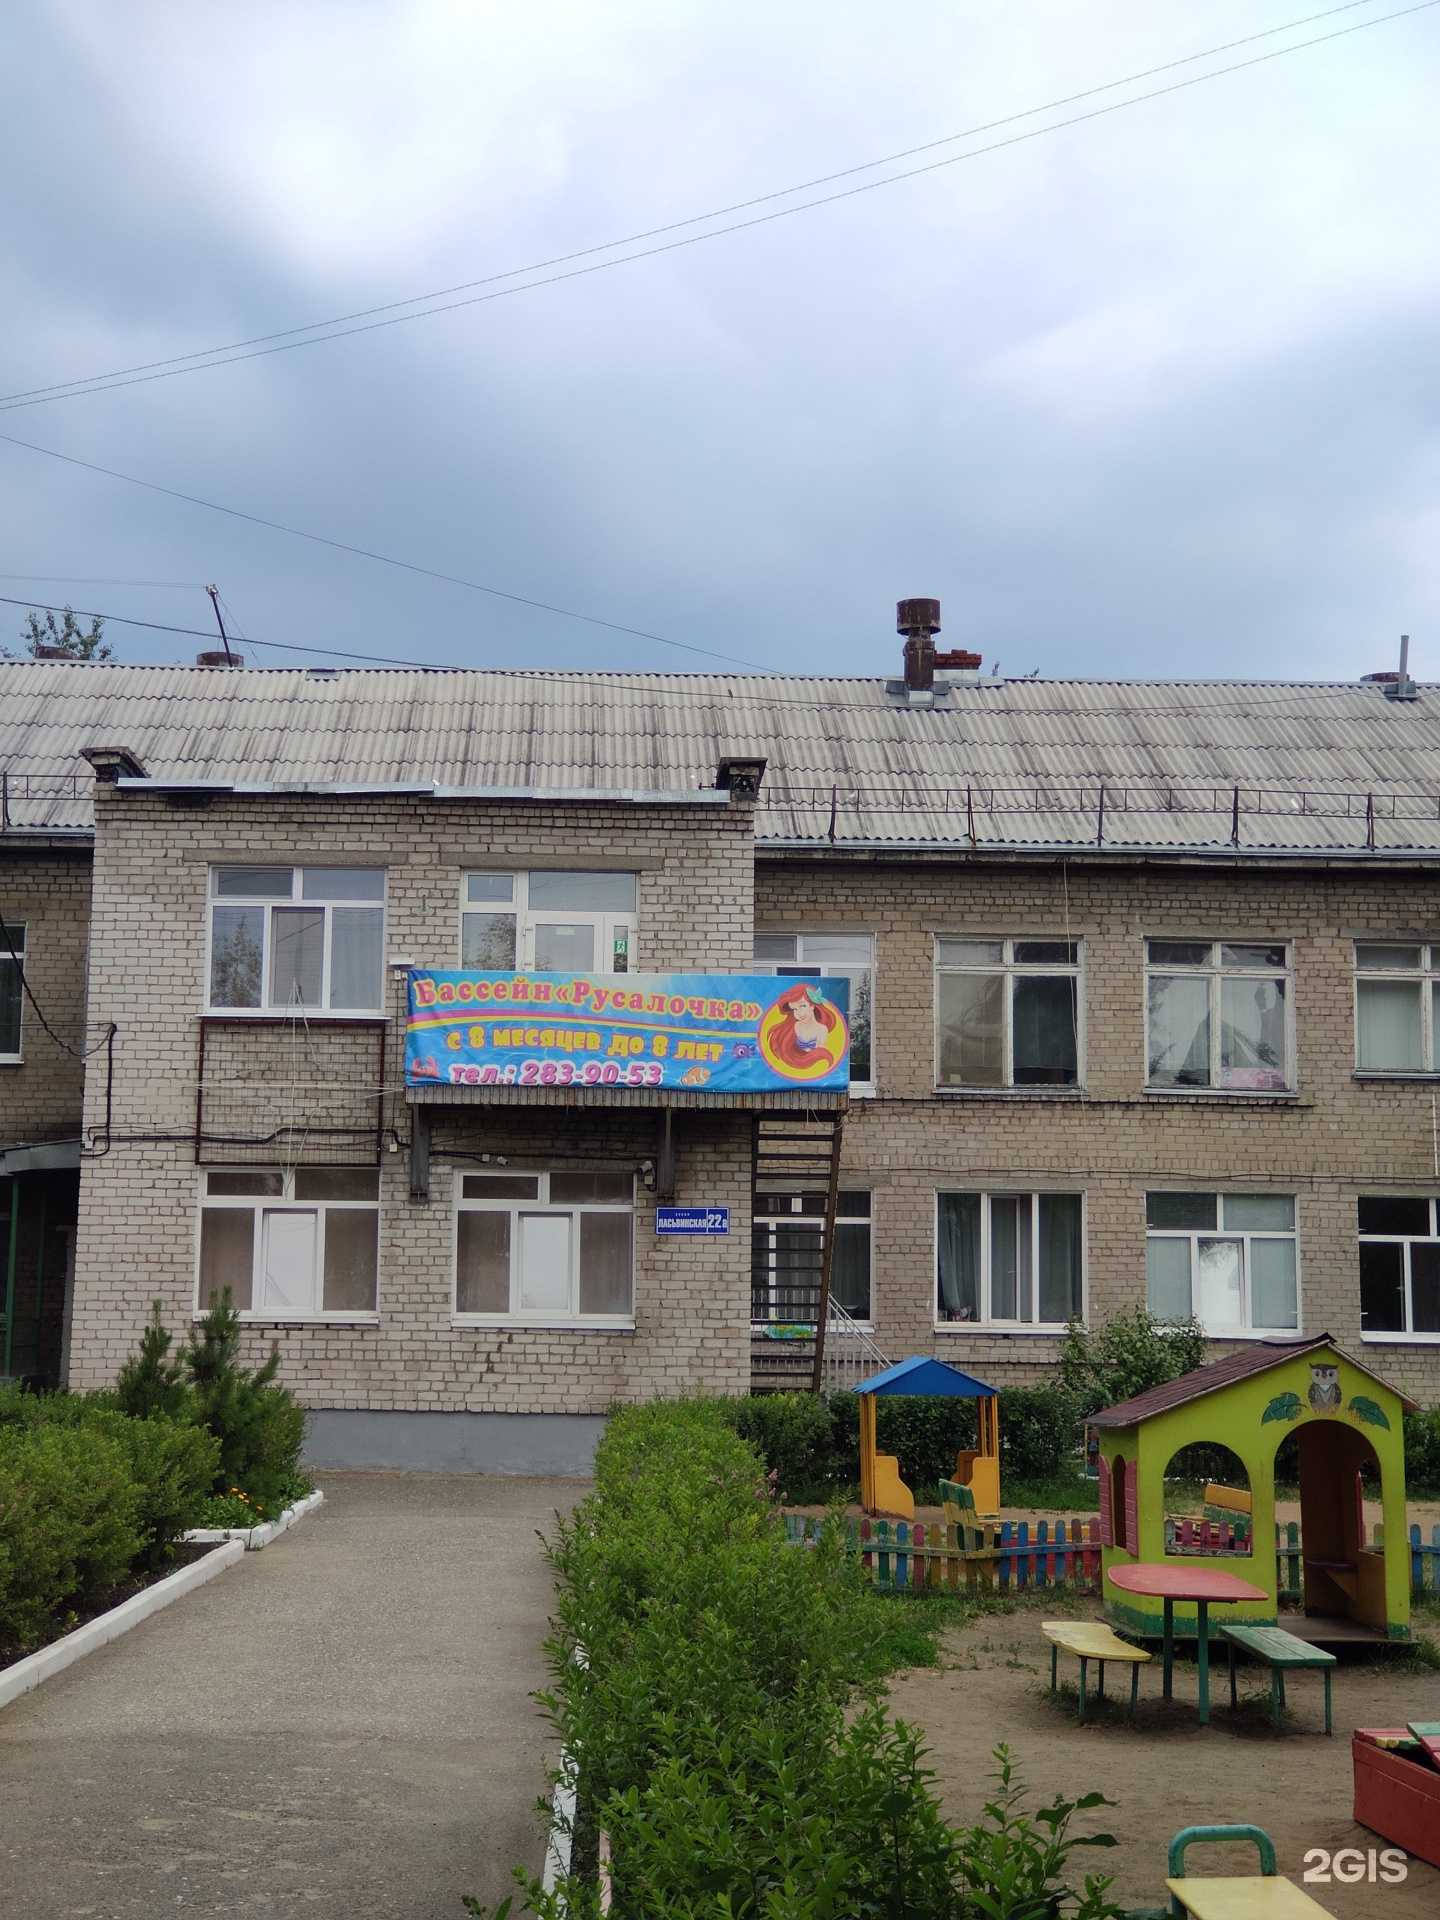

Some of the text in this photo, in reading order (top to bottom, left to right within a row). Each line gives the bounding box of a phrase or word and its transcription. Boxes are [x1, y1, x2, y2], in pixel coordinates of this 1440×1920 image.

[414, 977, 763, 1021] Бассейн «Русалочка»
[468, 1026, 485, 1048] 8
[652, 1034, 669, 1057] 8
[520, 1060, 664, 1086] 283-90-53
